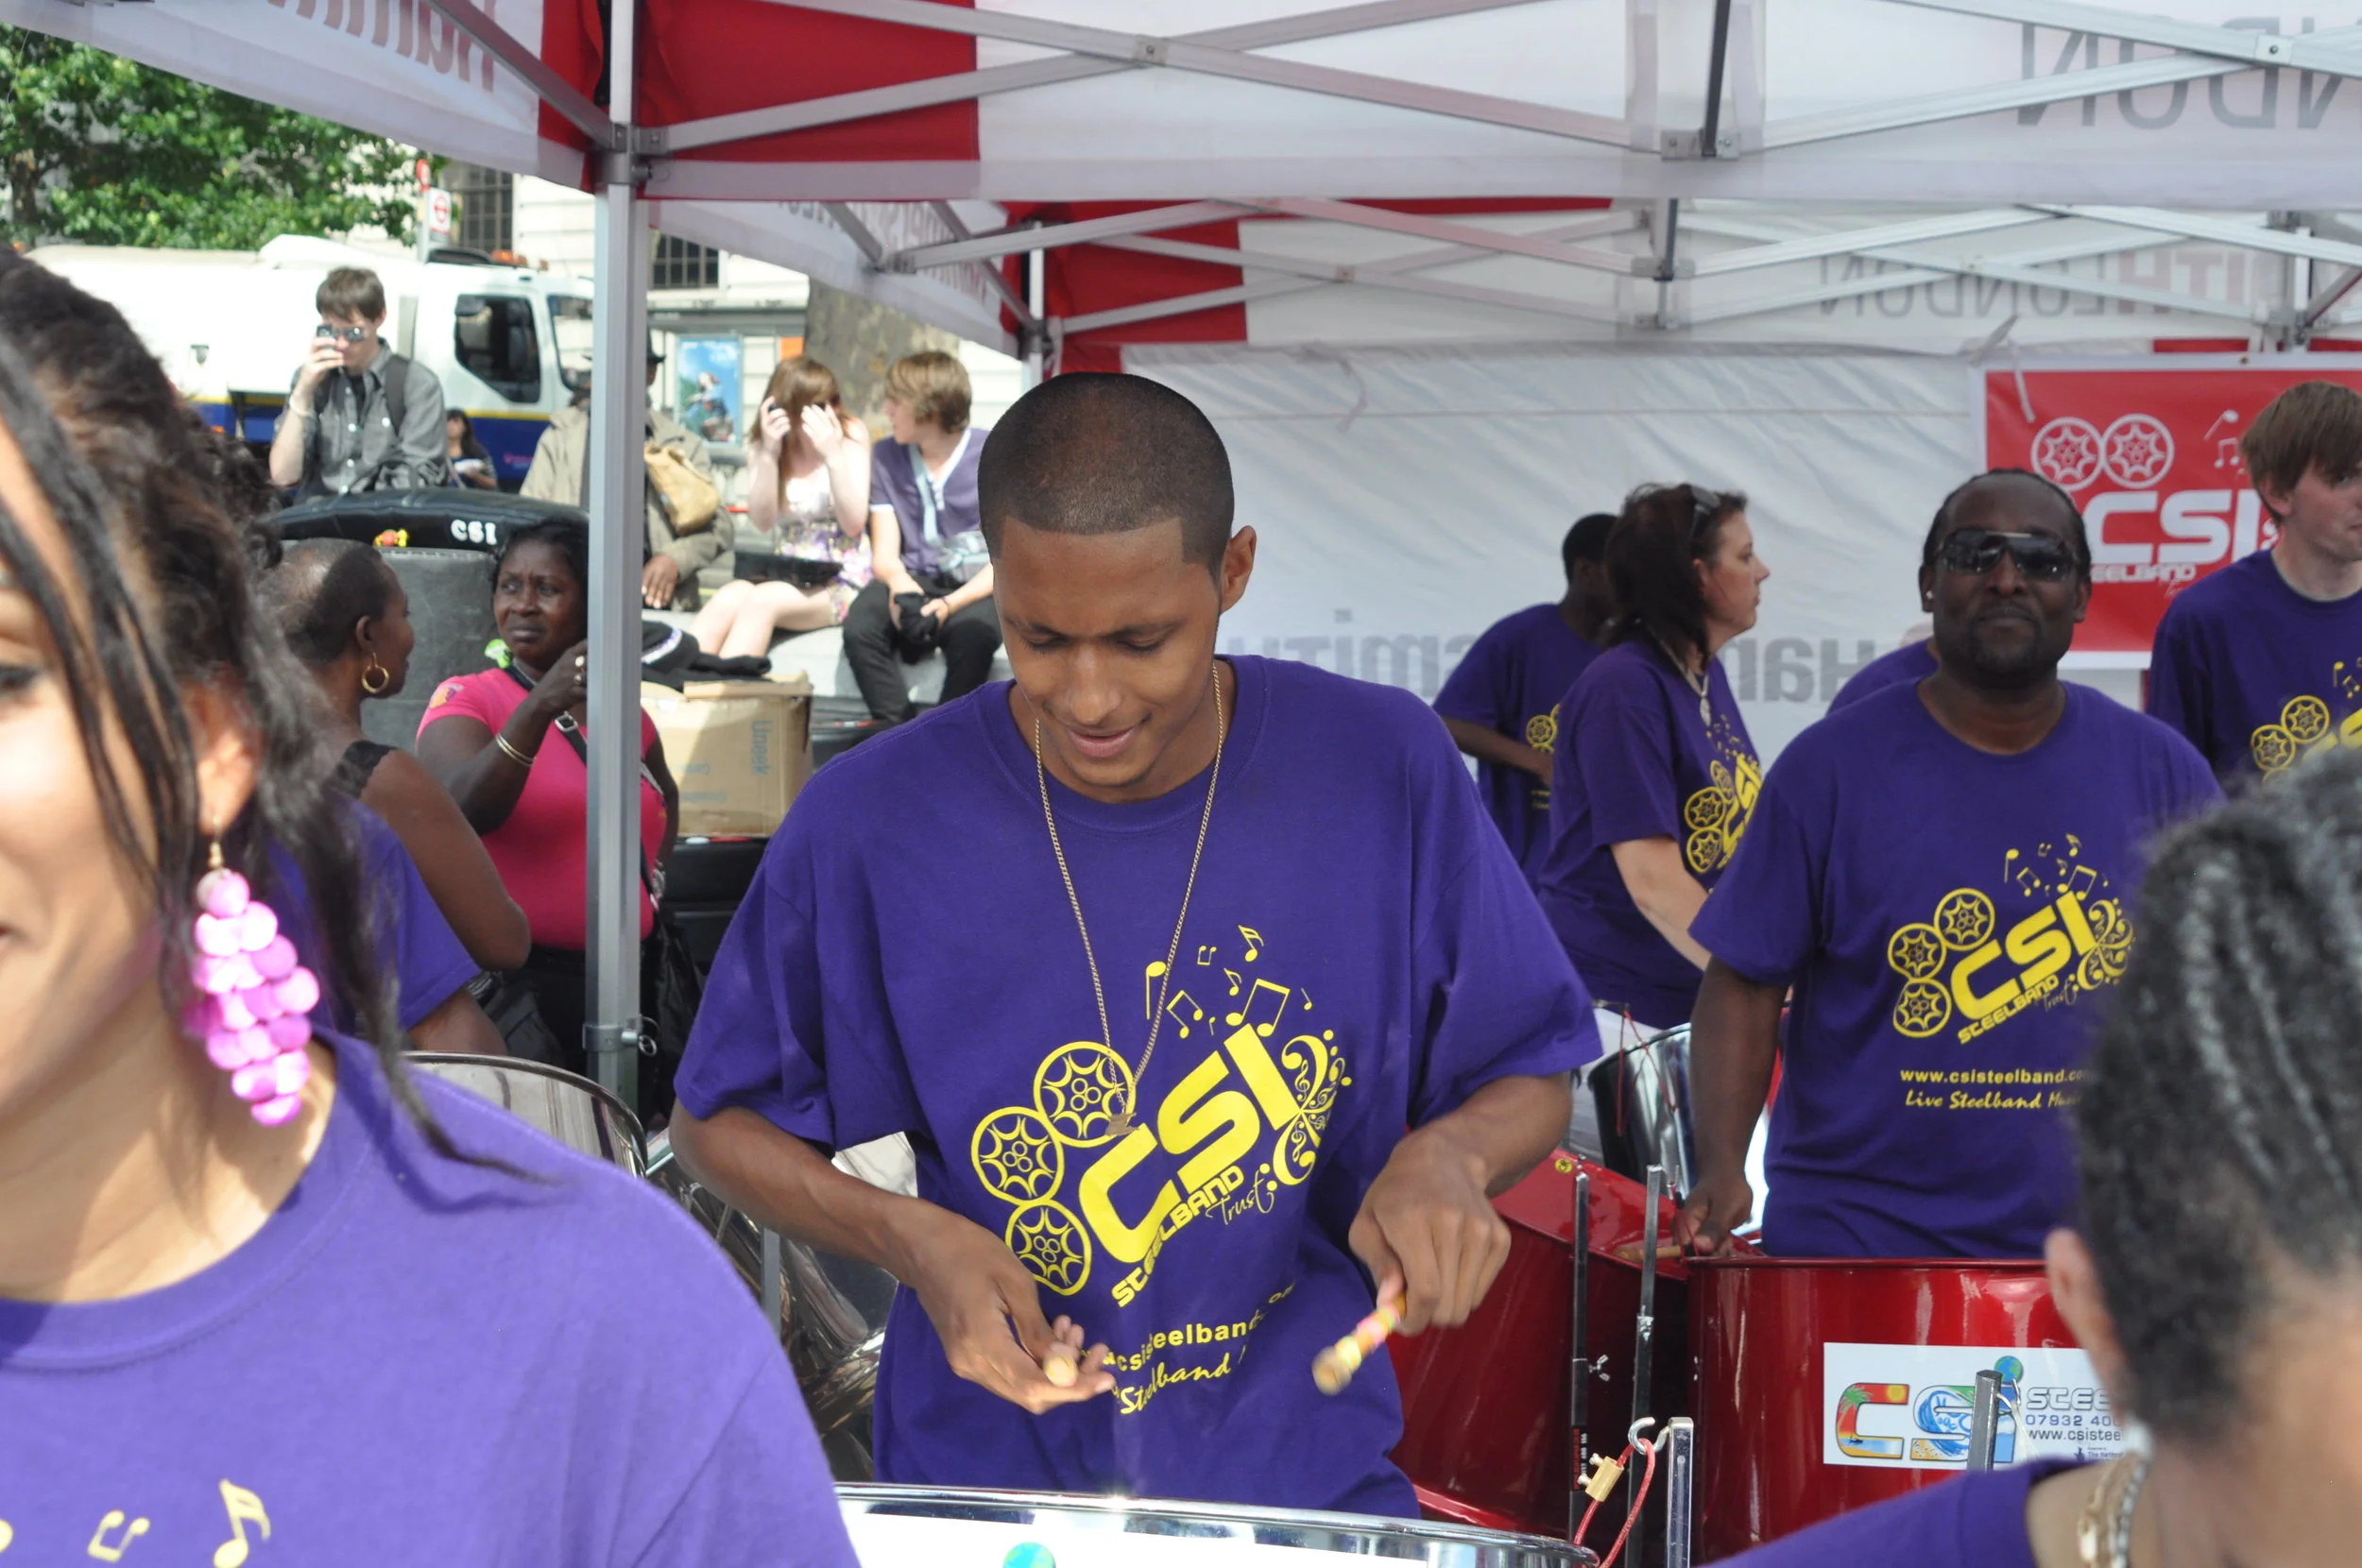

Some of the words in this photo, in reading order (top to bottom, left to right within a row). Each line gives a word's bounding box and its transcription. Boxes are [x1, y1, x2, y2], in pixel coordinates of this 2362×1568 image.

[2083, 489, 2266, 564] CSI
[1951, 890, 2099, 1021] CSI
[1958, 974, 2060, 1045] STEELBAND
[1906, 1089, 1943, 1108] Live
[1949, 1091, 2041, 1110] Steelband
[1079, 1024, 1300, 1264] CSI
[1205, 1168, 1275, 1225] Trust
[2026, 1414, 2082, 1426] 07932
